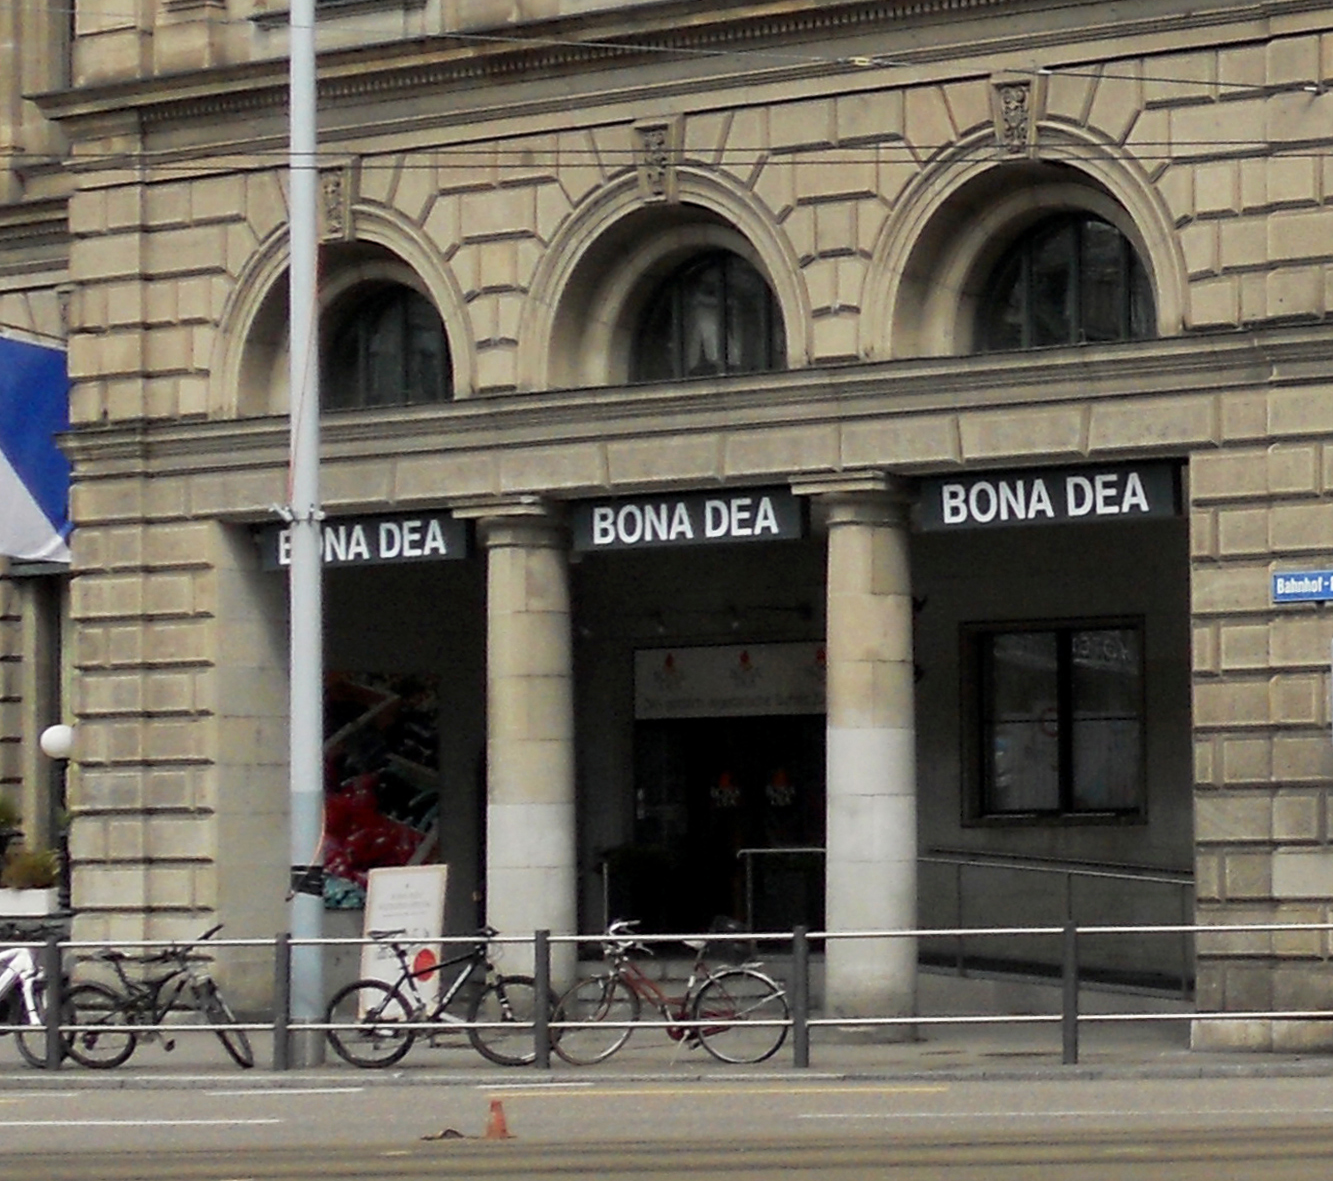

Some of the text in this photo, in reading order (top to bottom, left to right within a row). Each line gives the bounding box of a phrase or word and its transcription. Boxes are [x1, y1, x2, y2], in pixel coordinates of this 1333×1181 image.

[593, 497, 779, 544] BONA DEA
[942, 472, 1150, 524] BONA DEA
[279, 520, 447, 565] BNA DEA
